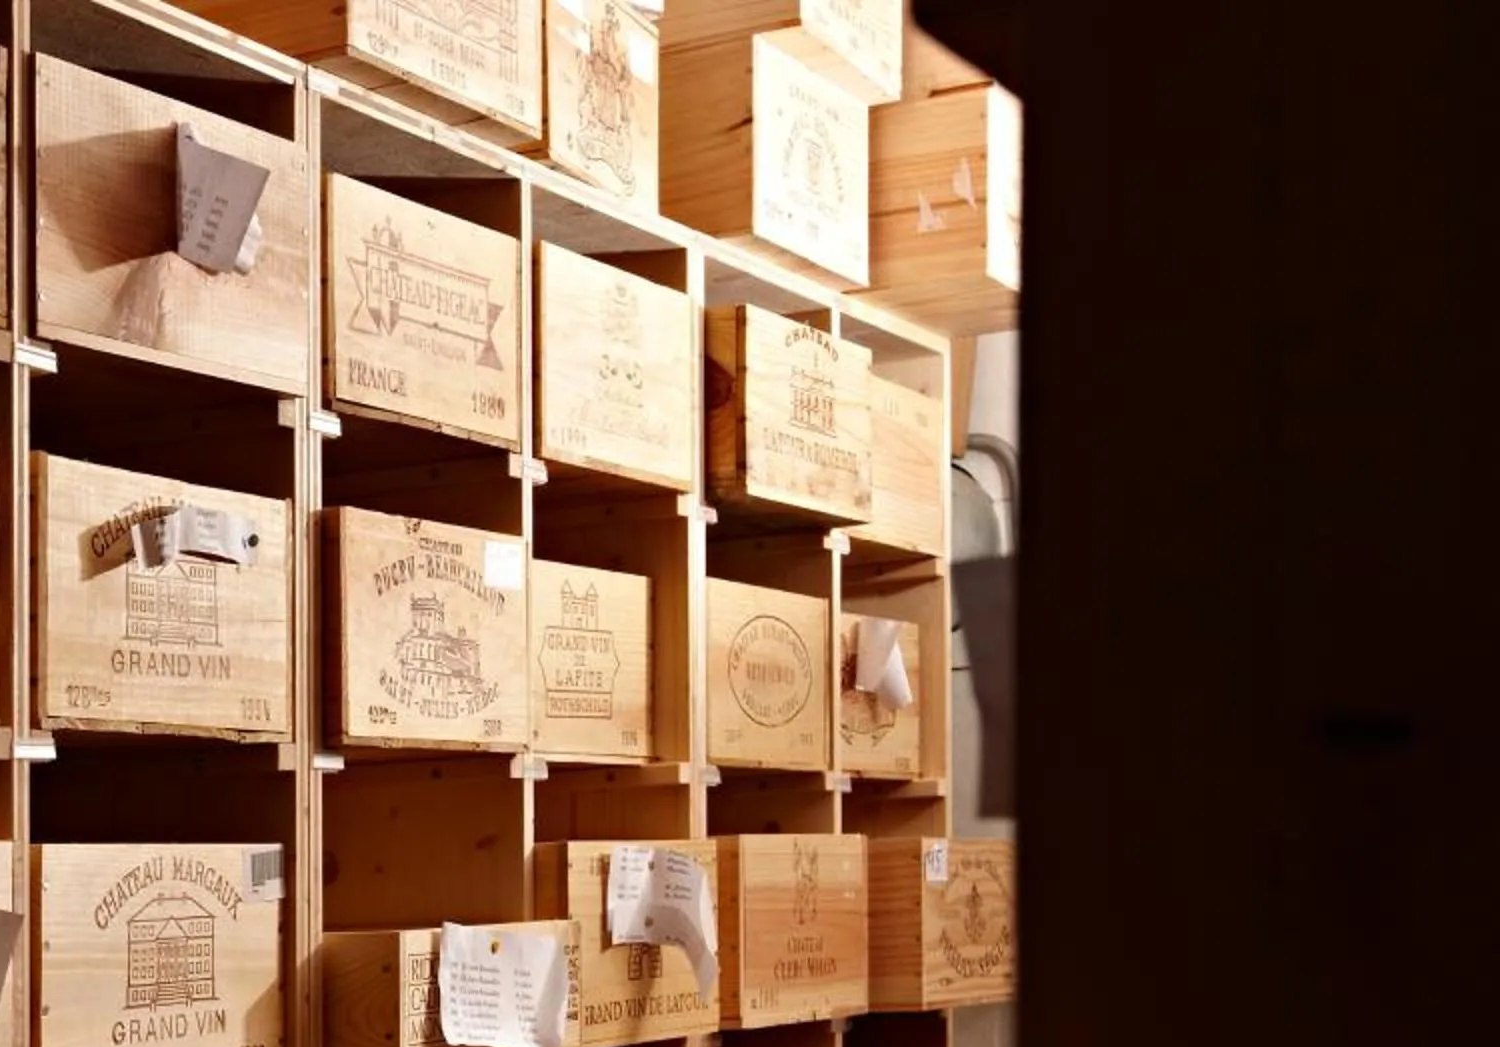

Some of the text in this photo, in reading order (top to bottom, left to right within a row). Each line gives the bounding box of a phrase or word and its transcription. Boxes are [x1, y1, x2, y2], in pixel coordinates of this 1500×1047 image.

[347, 357, 408, 397] FRANCE
[549, 632, 611, 654] GRAND VIN
[111, 649, 232, 680] GRAND VIN
[93, 855, 244, 931] CHATEAU MARGAUX
[665, 991, 710, 1013] LATOU
[111, 1008, 227, 1046] GRAND VIN
